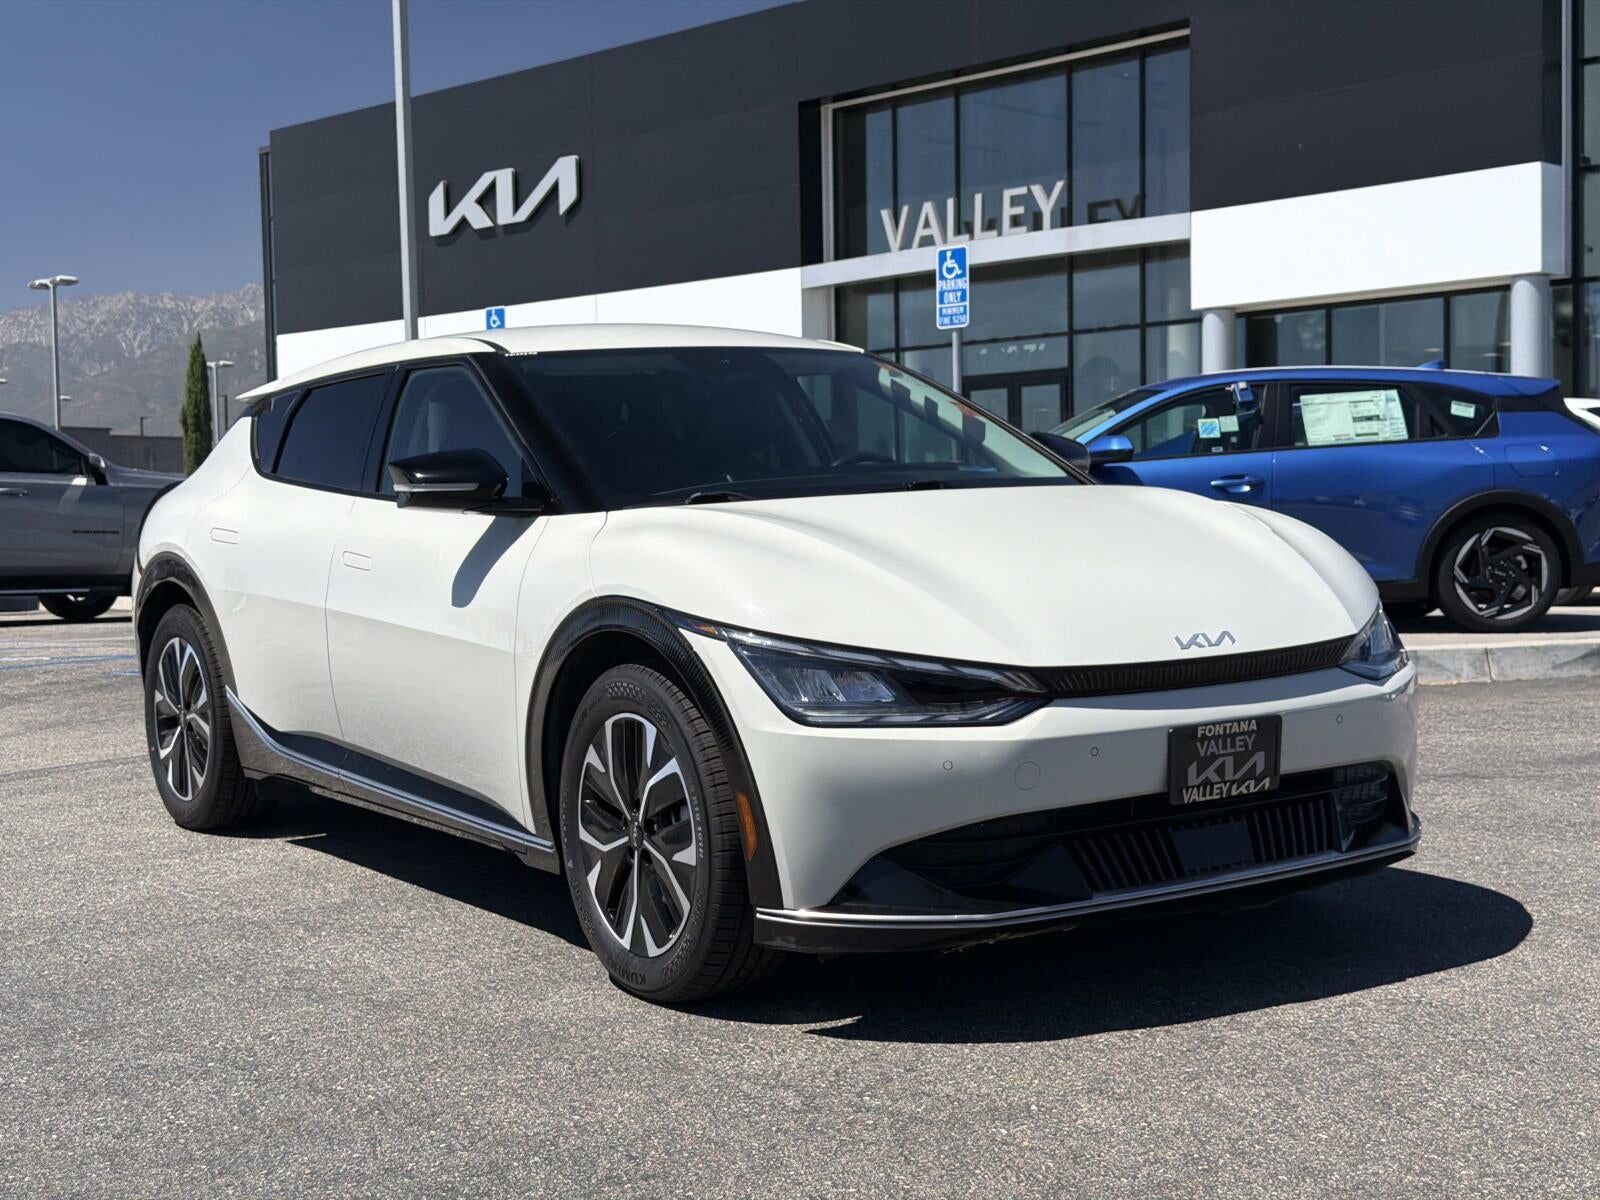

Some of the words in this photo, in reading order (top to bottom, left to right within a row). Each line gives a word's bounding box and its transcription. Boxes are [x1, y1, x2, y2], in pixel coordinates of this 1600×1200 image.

[428, 155, 580, 237] KIA
[880, 180, 1066, 251] VALLEY
[938, 278, 967, 291] PARKING
[943, 291, 962, 304] ONLY
[1174, 630, 1237, 650] KIA
[1197, 720, 1257, 738] FONTANA
[1196, 733, 1256, 757] VALLEY
[1187, 751, 1265, 786] KIA
[1182, 782, 1231, 804] VALLEY
[1231, 776, 1271, 796] KIA
